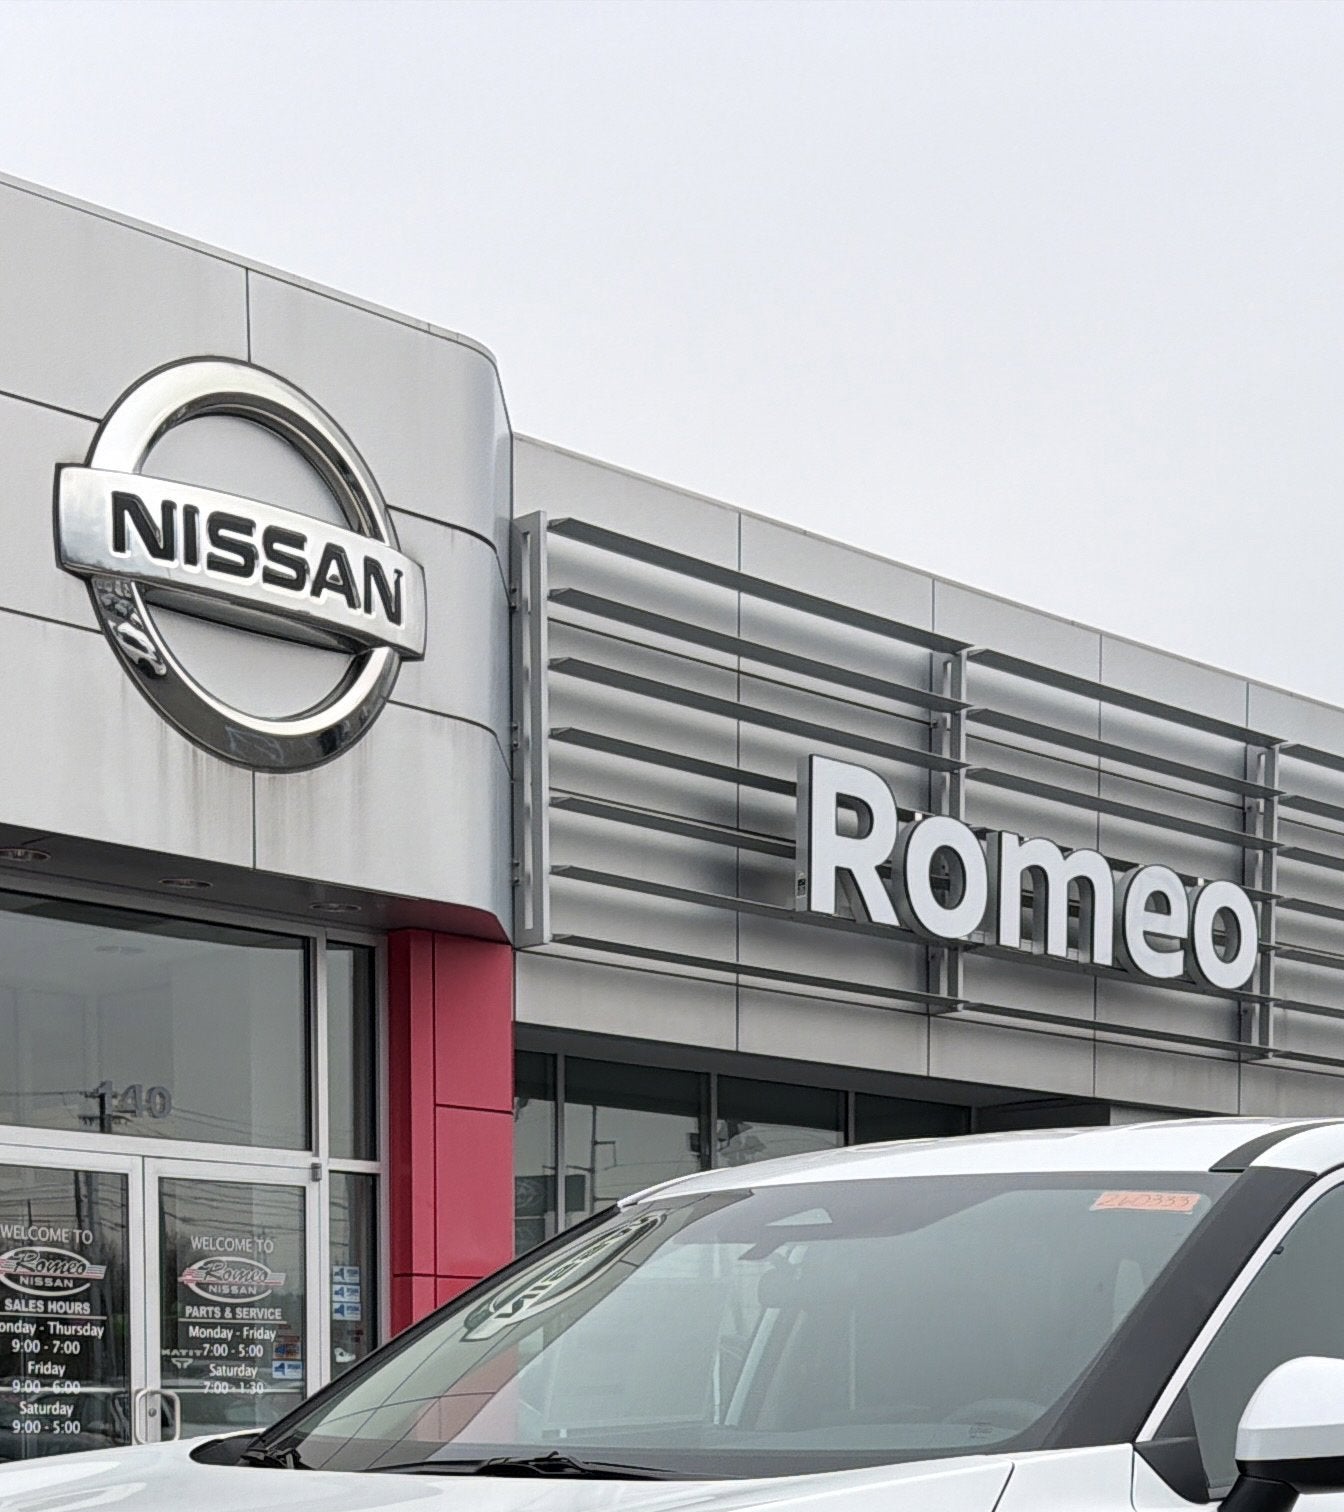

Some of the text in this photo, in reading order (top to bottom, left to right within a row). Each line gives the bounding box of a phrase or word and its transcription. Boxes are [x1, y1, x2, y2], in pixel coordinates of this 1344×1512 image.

[111, 490, 404, 627] NISSAN
[806, 753, 1258, 990] Romeo
[97, 1080, 172, 1119] 140
[0, 1224, 93, 1245] WELCOME TO
[191, 1236, 274, 1254] WELCOME TO
[11, 1250, 87, 1276] Romeo
[199, 1260, 269, 1282] Romeo
[19, 1276, 74, 1288] NISSAN
[208, 1285, 257, 1295] NISSAN
[4, 1298, 91, 1315] SALES HOURS
[185, 1306, 282, 1320] PARTS & SERVICE
[47, 1321, 105, 1339] Thursday
[189, 1325, 233, 1341] Monday
[243, 1326, 276, 1342] Friday
[11, 1339, 41, 1353] 9:00
[52, 1340, 81, 1354] 7:00
[202, 1343, 229, 1357] 7:00
[238, 1344, 264, 1357] 5:00
[27, 1361, 66, 1377] Friday
[209, 1363, 258, 1379] Saturday
[12, 1379, 41, 1393] 9:00
[52, 1380, 81, 1394] 6:00
[203, 1381, 229, 1395] 7:00
[240, 1381, 264, 1395] 1:30
[19, 1401, 74, 1417] Saturday
[12, 1420, 41, 1434] 9:00
[52, 1420, 81, 1435] 5:00
